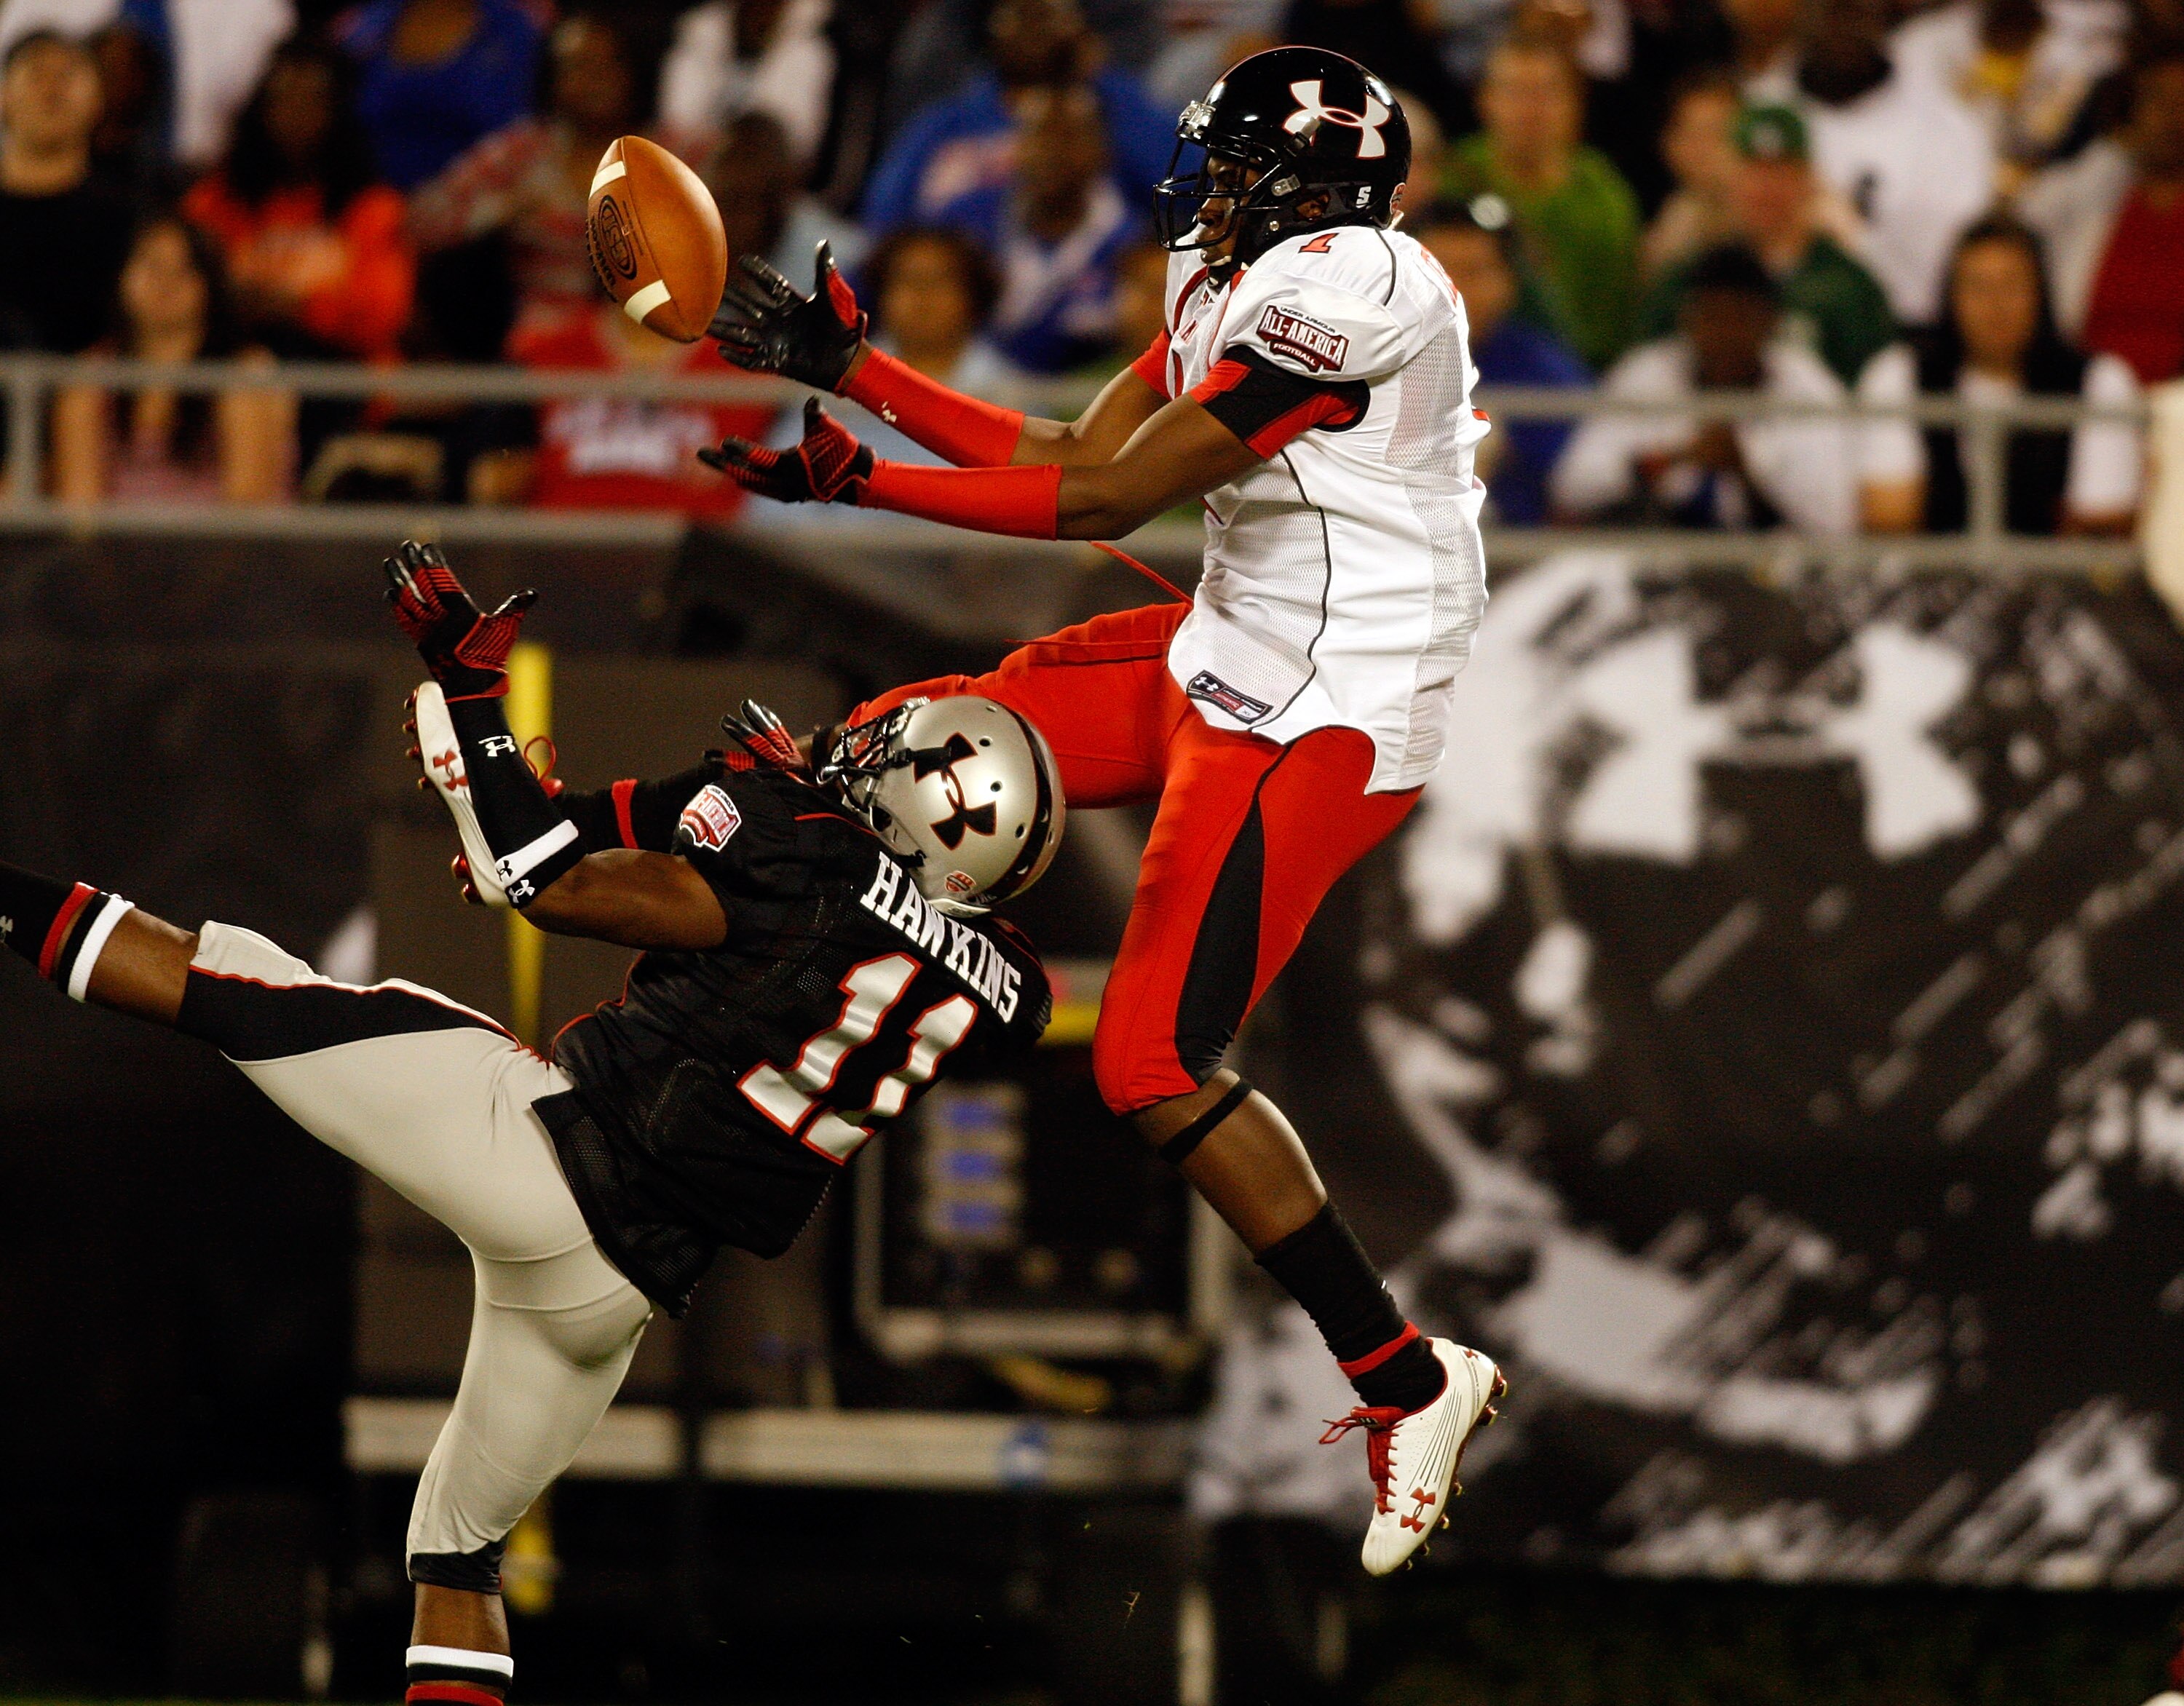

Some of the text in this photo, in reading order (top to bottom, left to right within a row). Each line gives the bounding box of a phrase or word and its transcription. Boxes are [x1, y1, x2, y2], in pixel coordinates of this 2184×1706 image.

[1297, 232, 1340, 254] 1
[1259, 307, 1347, 366] ALL-AMERICA
[1280, 306, 1336, 334] UNDER ARMOUR
[1273, 343, 1316, 366] FOOTBALL
[860, 851, 1021, 1023] HAWKINS
[736, 951, 978, 1166] 11
